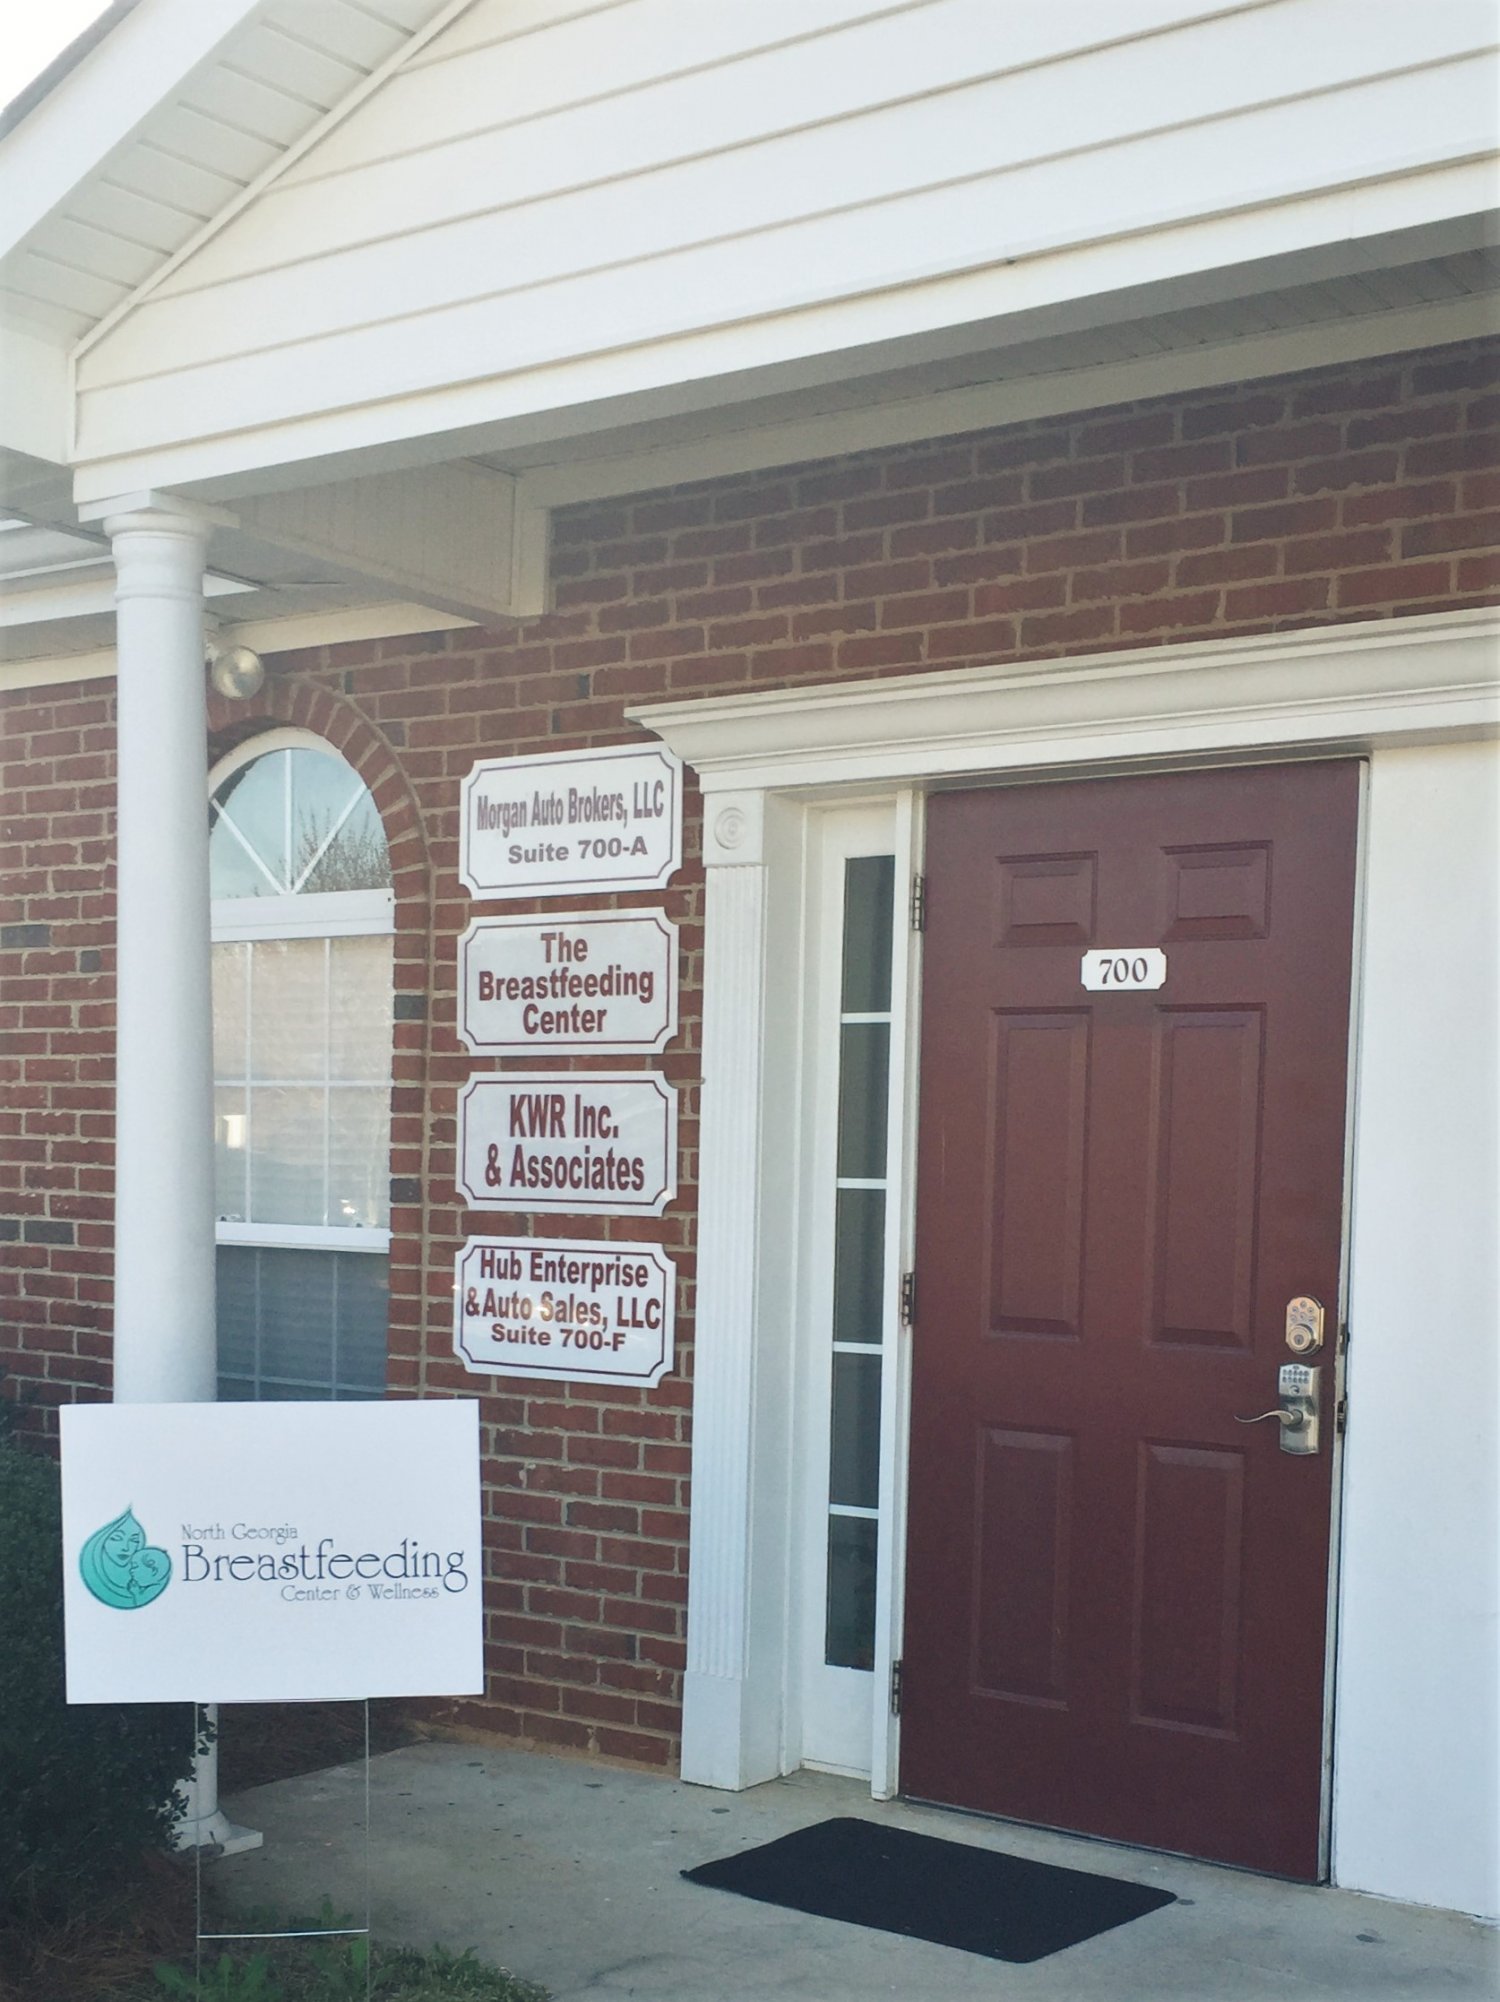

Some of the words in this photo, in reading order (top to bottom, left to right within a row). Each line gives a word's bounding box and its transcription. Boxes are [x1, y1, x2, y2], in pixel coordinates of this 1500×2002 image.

[477, 795, 527, 838] Morgan
[531, 791, 564, 827] Auto
[568, 786, 628, 828] Brokers,
[633, 780, 664, 819] LLC
[508, 843, 569, 864] Suite
[578, 836, 648, 860] 700-A
[541, 932, 588, 963] The
[479, 965, 654, 1004] Breastfeeding
[1099, 957, 1148, 984] 700
[523, 1003, 607, 1035] Center
[509, 1094, 566, 1138] KWR
[574, 1094, 619, 1139] Inc.
[485, 1143, 501, 1187] &
[509, 1144, 644, 1191] Associates
[480, 1249, 522, 1281] Hub
[530, 1252, 648, 1292] Enterprise
[540, 1291, 608, 1332] Sales,
[617, 1296, 661, 1329] LLC
[491, 1323, 551, 1346] Suite
[559, 1328, 626, 1351] 700-F
[181, 1523, 225, 1540] North
[231, 1523, 298, 1544] Georgia
[182, 1538, 468, 1592] Breastfeeding
[280, 1584, 338, 1601] Center
[346, 1584, 361, 1600] &
[368, 1583, 439, 1599] Wellness
